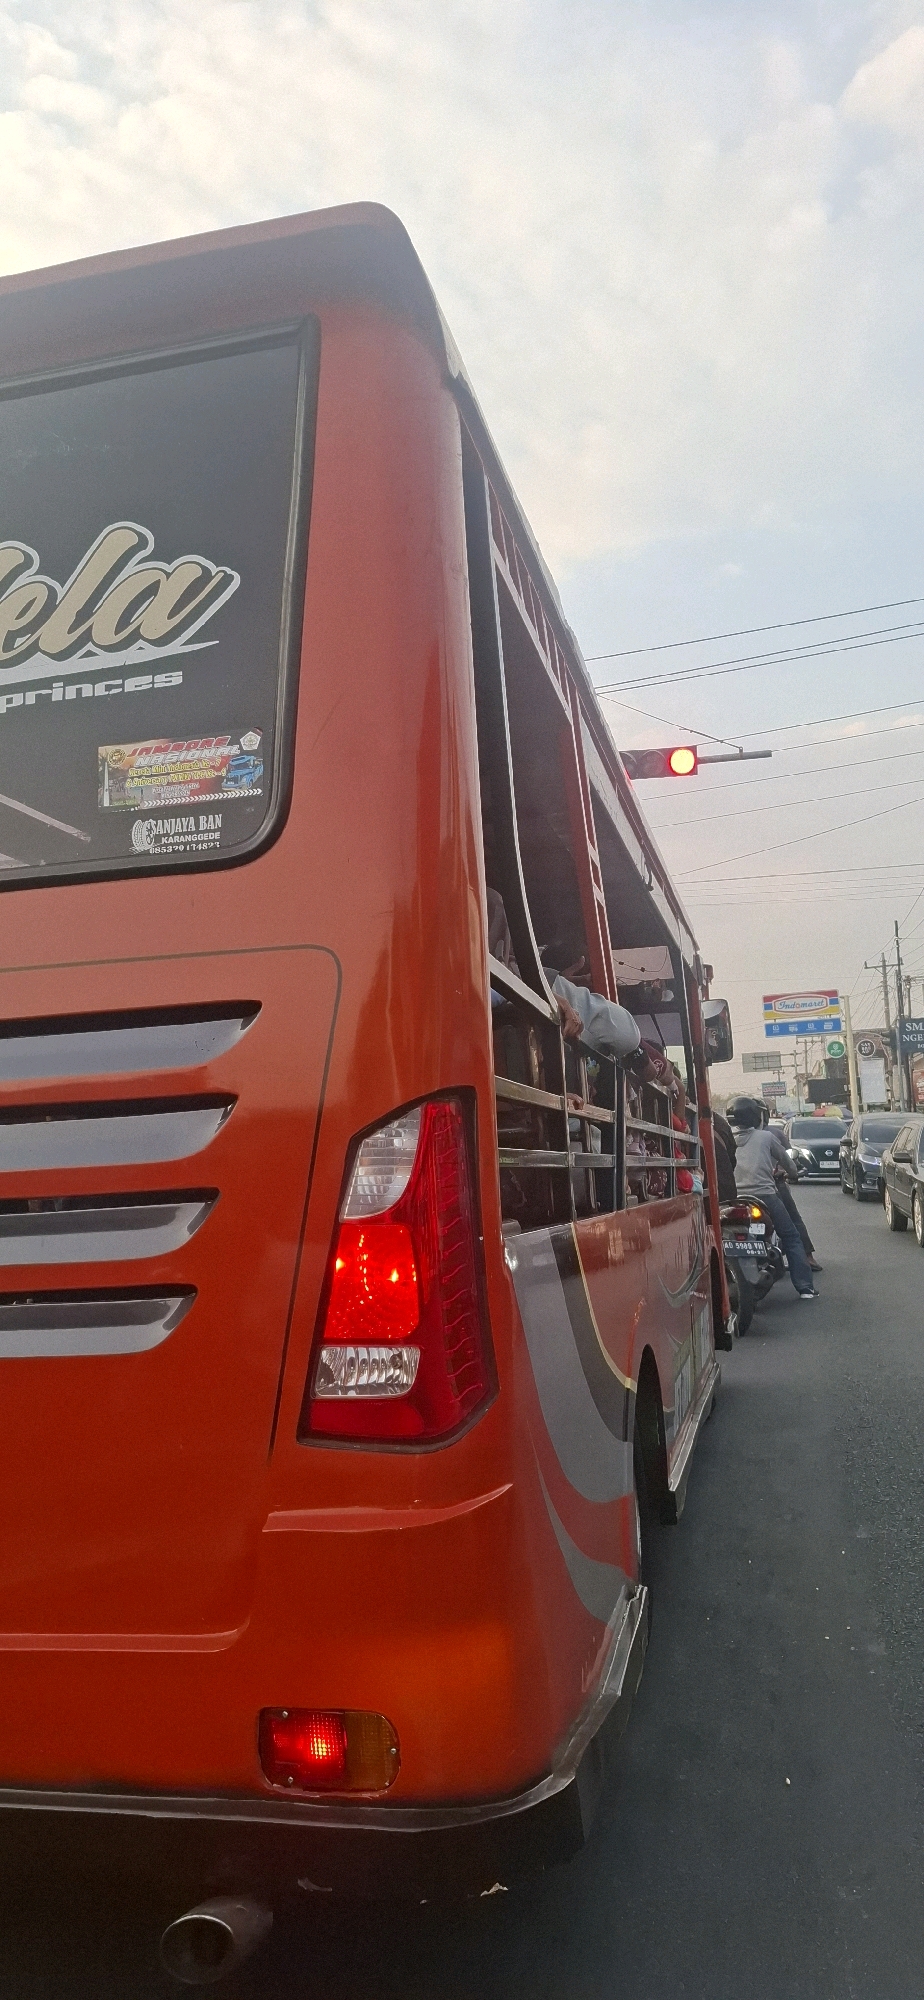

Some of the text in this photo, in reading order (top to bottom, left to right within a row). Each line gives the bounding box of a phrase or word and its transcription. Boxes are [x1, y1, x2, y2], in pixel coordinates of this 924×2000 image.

[135, 744, 240, 766] NASIONAL
[151, 814, 223, 836] SANJAYA BAN
[162, 832, 221, 844] KARANGGEDE
[778, 999, 825, 1010] Indomaret
[901, 1033, 924, 1042] NGE
